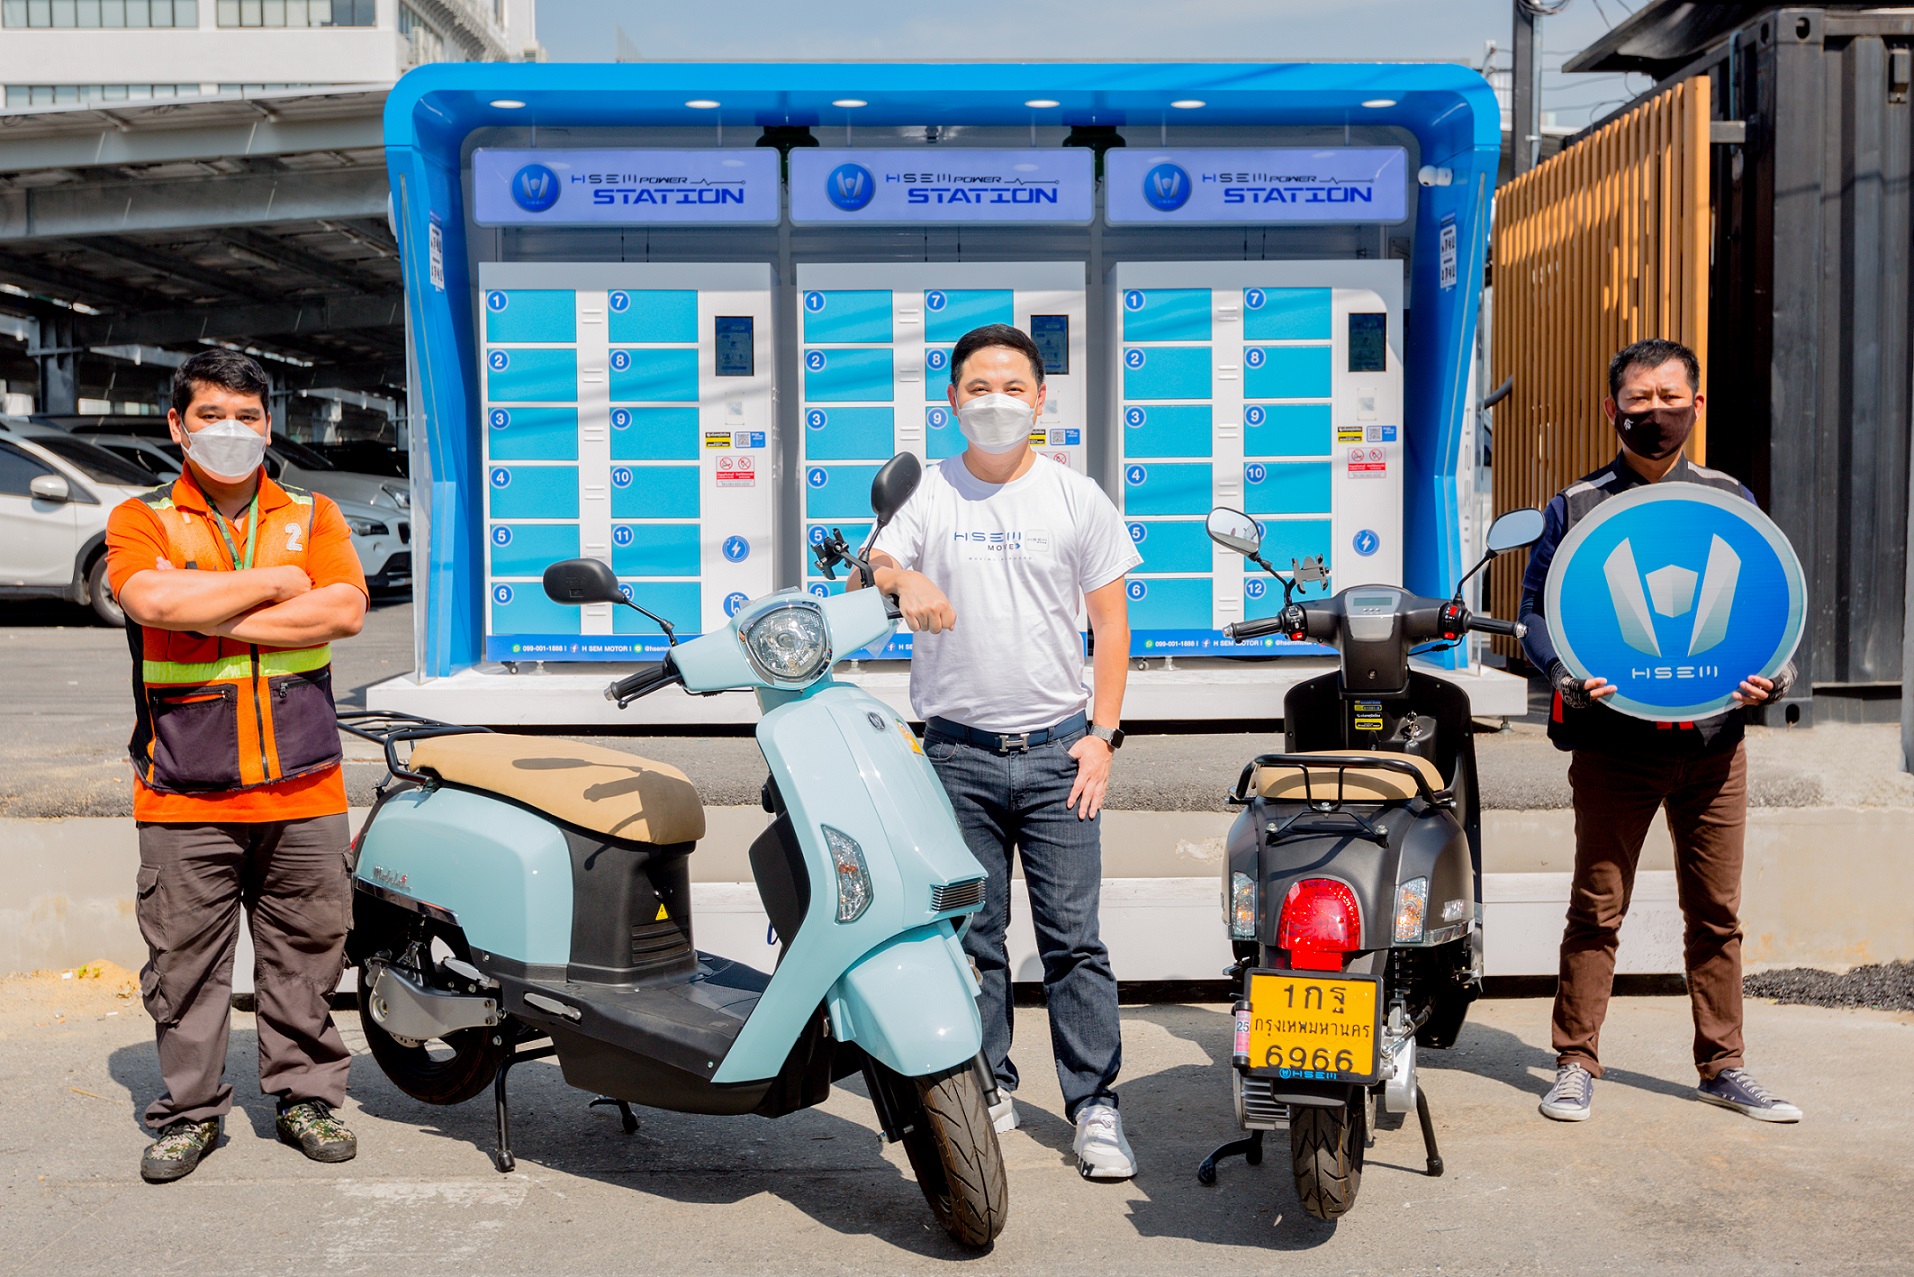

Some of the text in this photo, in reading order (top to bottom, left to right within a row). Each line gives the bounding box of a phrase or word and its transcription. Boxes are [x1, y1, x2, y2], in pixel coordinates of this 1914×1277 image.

[1269, 175, 1317, 183] POWER
[593, 188, 744, 204] STATION
[908, 188, 1058, 204] STATION
[1224, 187, 1372, 203] STATION
[493, 296, 500, 307] 1
[615, 296, 624, 307] 7
[810, 296, 817, 307] 1
[931, 296, 941, 307] 7
[1130, 295, 1137, 306] 1
[1251, 293, 1260, 304] 7
[494, 355, 503, 366] 2
[615, 355, 624, 366] 8
[811, 356, 820, 367] 2
[932, 354, 941, 365] 8
[1130, 353, 1139, 364] 2
[1250, 352, 1260, 363] 8
[495, 413, 504, 425] 3
[616, 413, 626, 424] 9
[812, 414, 821, 425] 3
[932, 413, 941, 424] 9
[1131, 412, 1140, 423] 3
[1250, 410, 1260, 421] 9
[496, 472, 505, 483] 4
[614, 472, 629, 483] 10
[812, 472, 822, 483] 4
[1131, 470, 1141, 480] 4
[1248, 468, 1262, 479] 10
[285, 523, 302, 551] 2
[497, 530, 506, 542] 5
[616, 531, 629, 541] 11
[814, 530, 823, 541] 5
[1131, 528, 1141, 539] 5
[815, 588, 824, 598] 6
[1132, 585, 1141, 596] 6
[1248, 583, 1262, 594] 12
[498, 589, 507, 600] 6
[1255, 1018, 1370, 1038] กรุงเทพมหานคร
[1265, 1045, 1353, 1071] 6966
